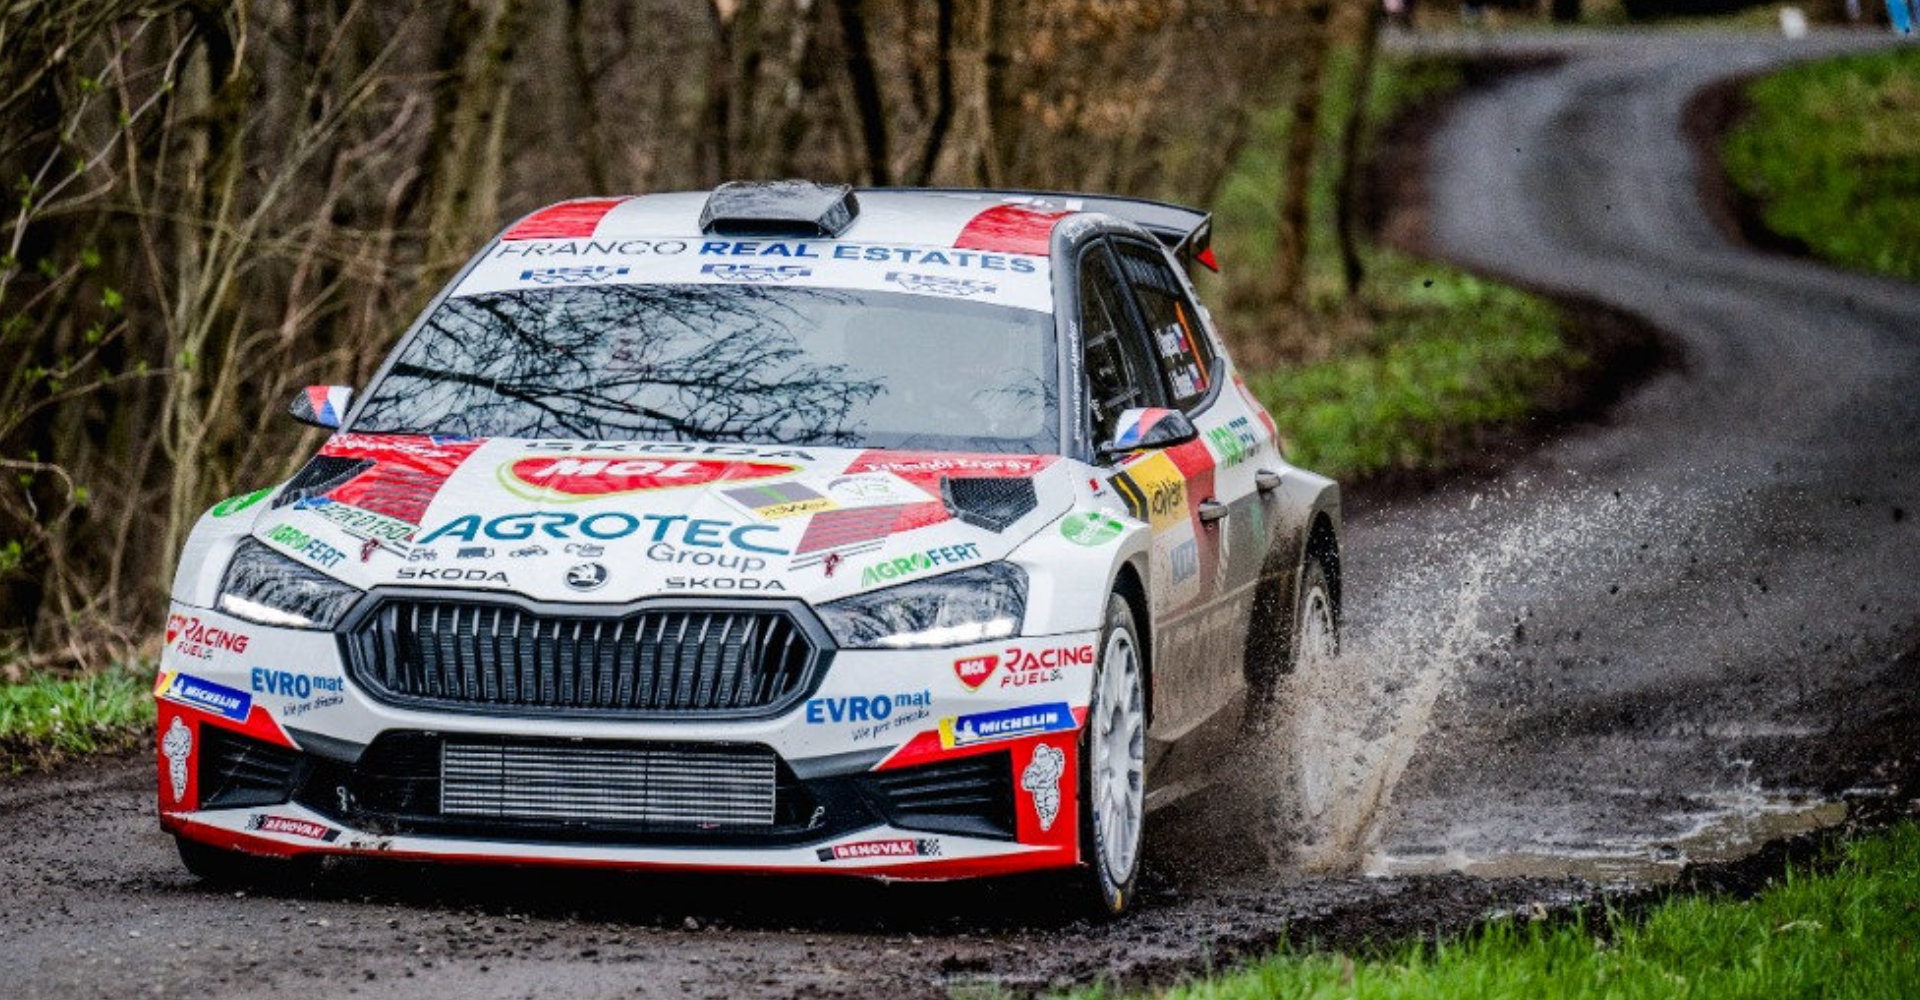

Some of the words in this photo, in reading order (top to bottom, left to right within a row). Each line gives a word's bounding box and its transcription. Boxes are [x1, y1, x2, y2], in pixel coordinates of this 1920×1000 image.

[497, 241, 688, 257] FRANCO
[699, 241, 819, 258] REAL
[833, 245, 1036, 273] ESTATES
[534, 459, 702, 477] MOL
[418, 511, 790, 556] AGROTEC
[646, 543, 766, 573] Group
[185, 617, 249, 654] RACING
[1004, 645, 1092, 673] RACING
[979, 712, 1058, 734] MICHELIN
